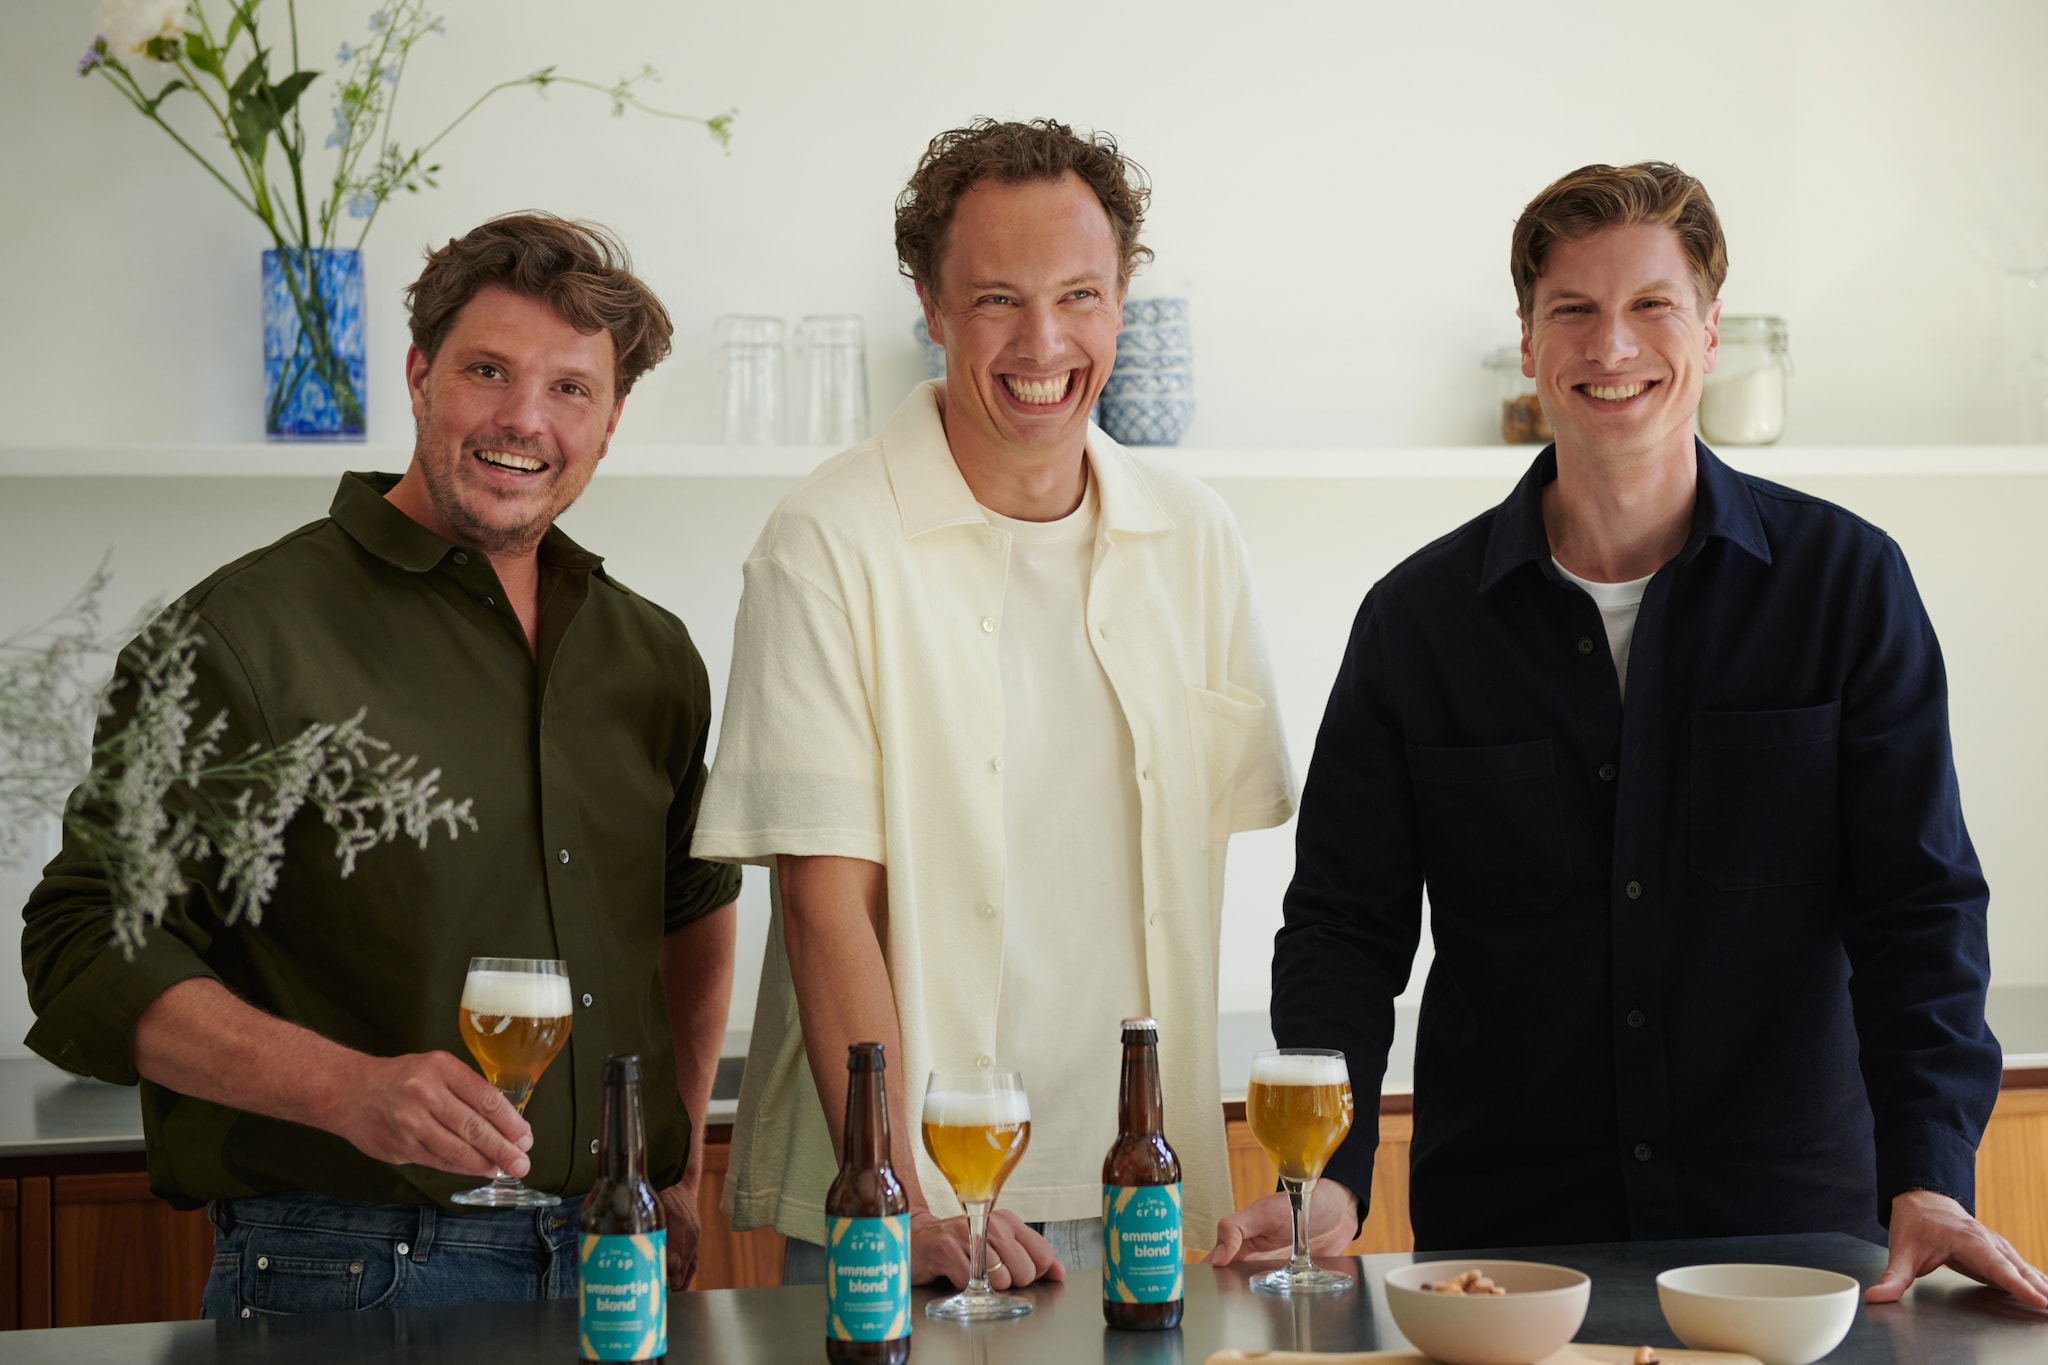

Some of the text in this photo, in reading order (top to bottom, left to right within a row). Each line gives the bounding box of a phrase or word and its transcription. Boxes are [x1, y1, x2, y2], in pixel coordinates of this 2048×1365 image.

[1121, 1227, 1178, 1243] emmertje
[1134, 1244, 1170, 1258] blond
[837, 1261, 899, 1278] emmertje
[586, 1281, 649, 1297] emmertje
[849, 1278, 888, 1294] blond
[596, 1297, 636, 1312] blond
